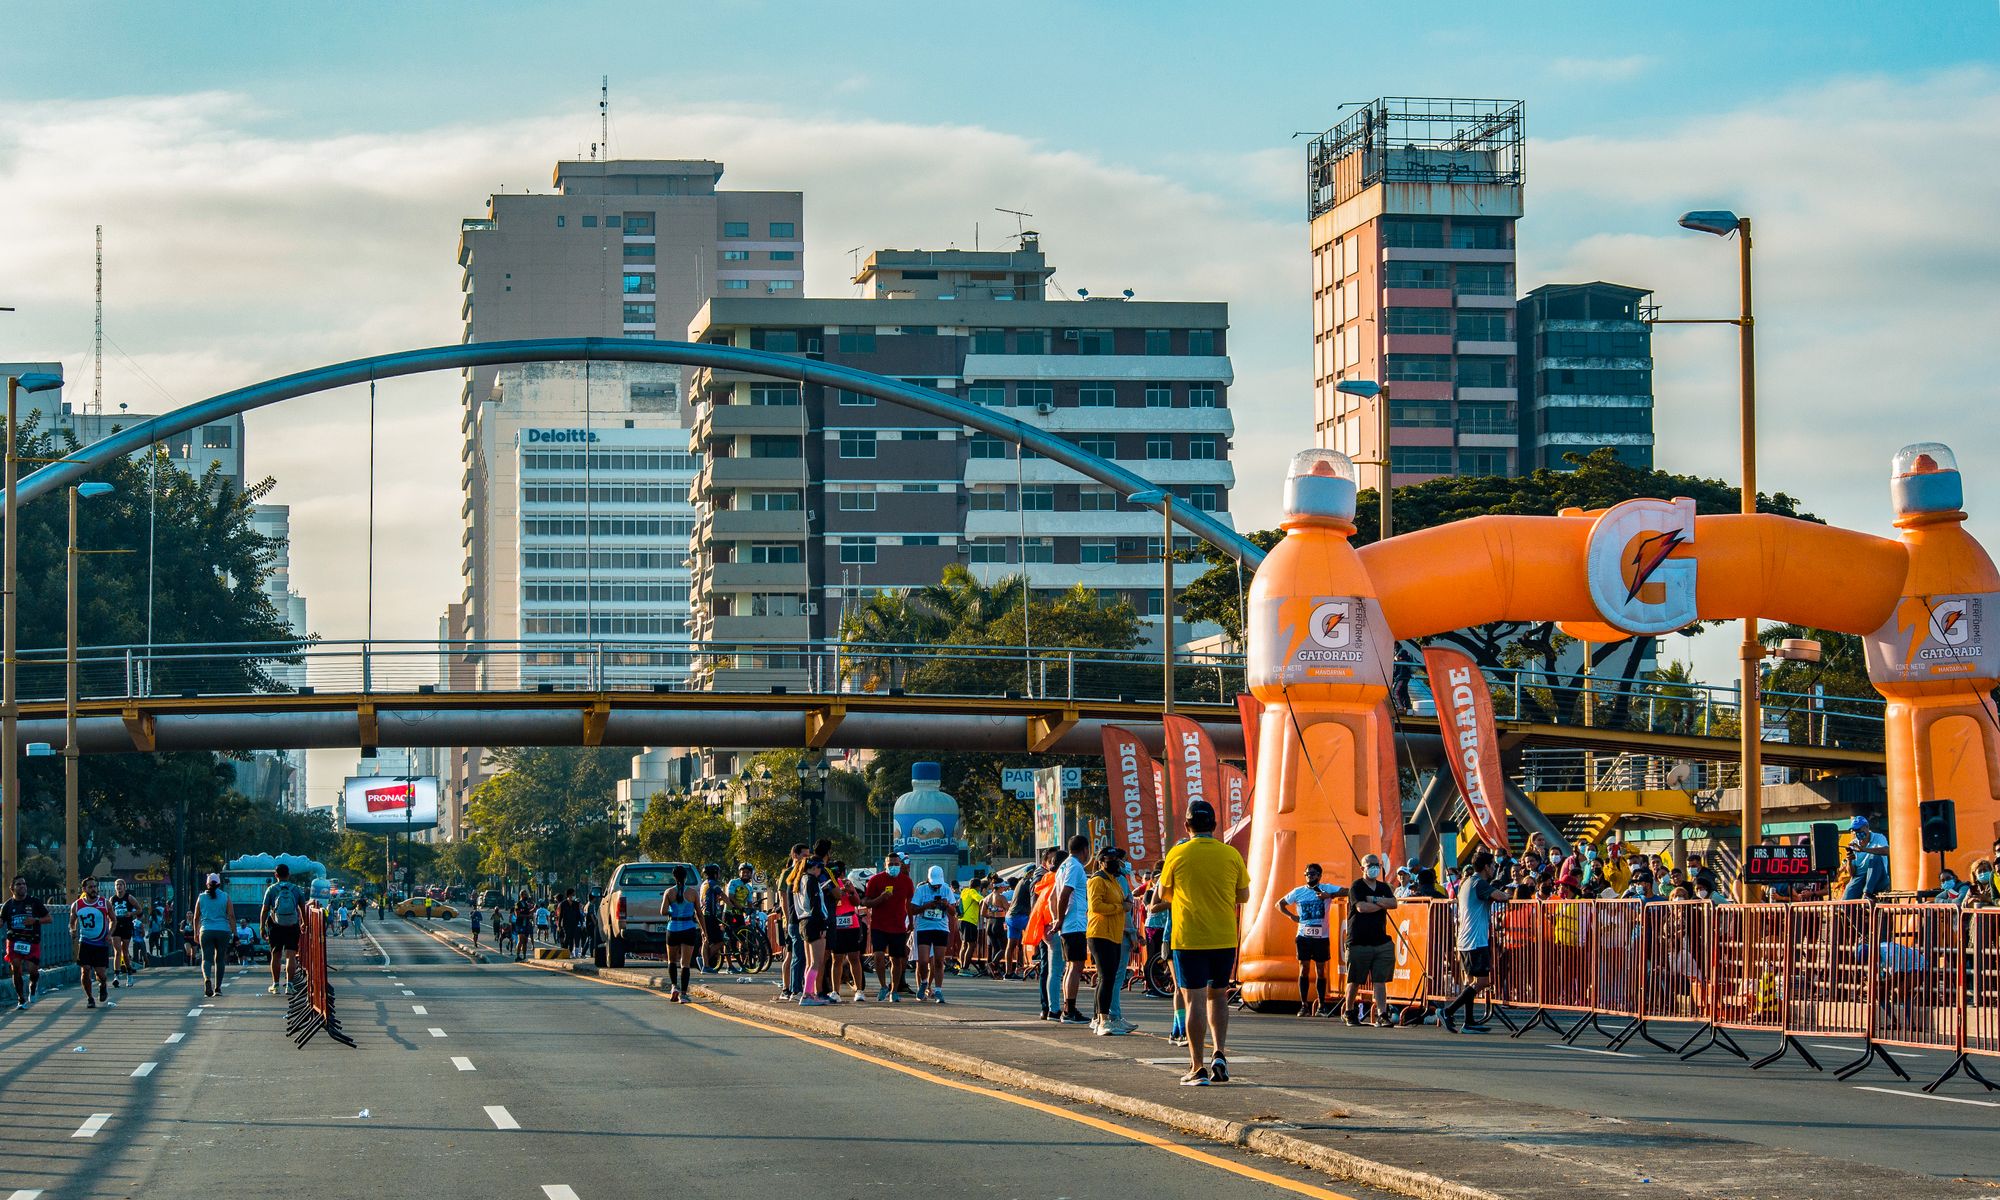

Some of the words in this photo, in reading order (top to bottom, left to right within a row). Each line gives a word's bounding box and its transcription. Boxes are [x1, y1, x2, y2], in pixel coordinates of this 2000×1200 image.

[1586, 497, 1698, 635] G
[1308, 602, 1350, 649] G
[1928, 600, 1969, 645] G
[1297, 650, 1363, 662] GATORADE
[1920, 646, 1983, 660] GATORADE
[1449, 666, 1491, 827] GATORADE
[367, 794, 412, 802] PRONAC
[1119, 743, 1146, 860] GATORADE
[1753, 848, 1769, 858] HRS.
[1774, 848, 1788, 858] MIN.
[1792, 848, 1808, 858] SEG.
[838, 917, 850, 925] 248
